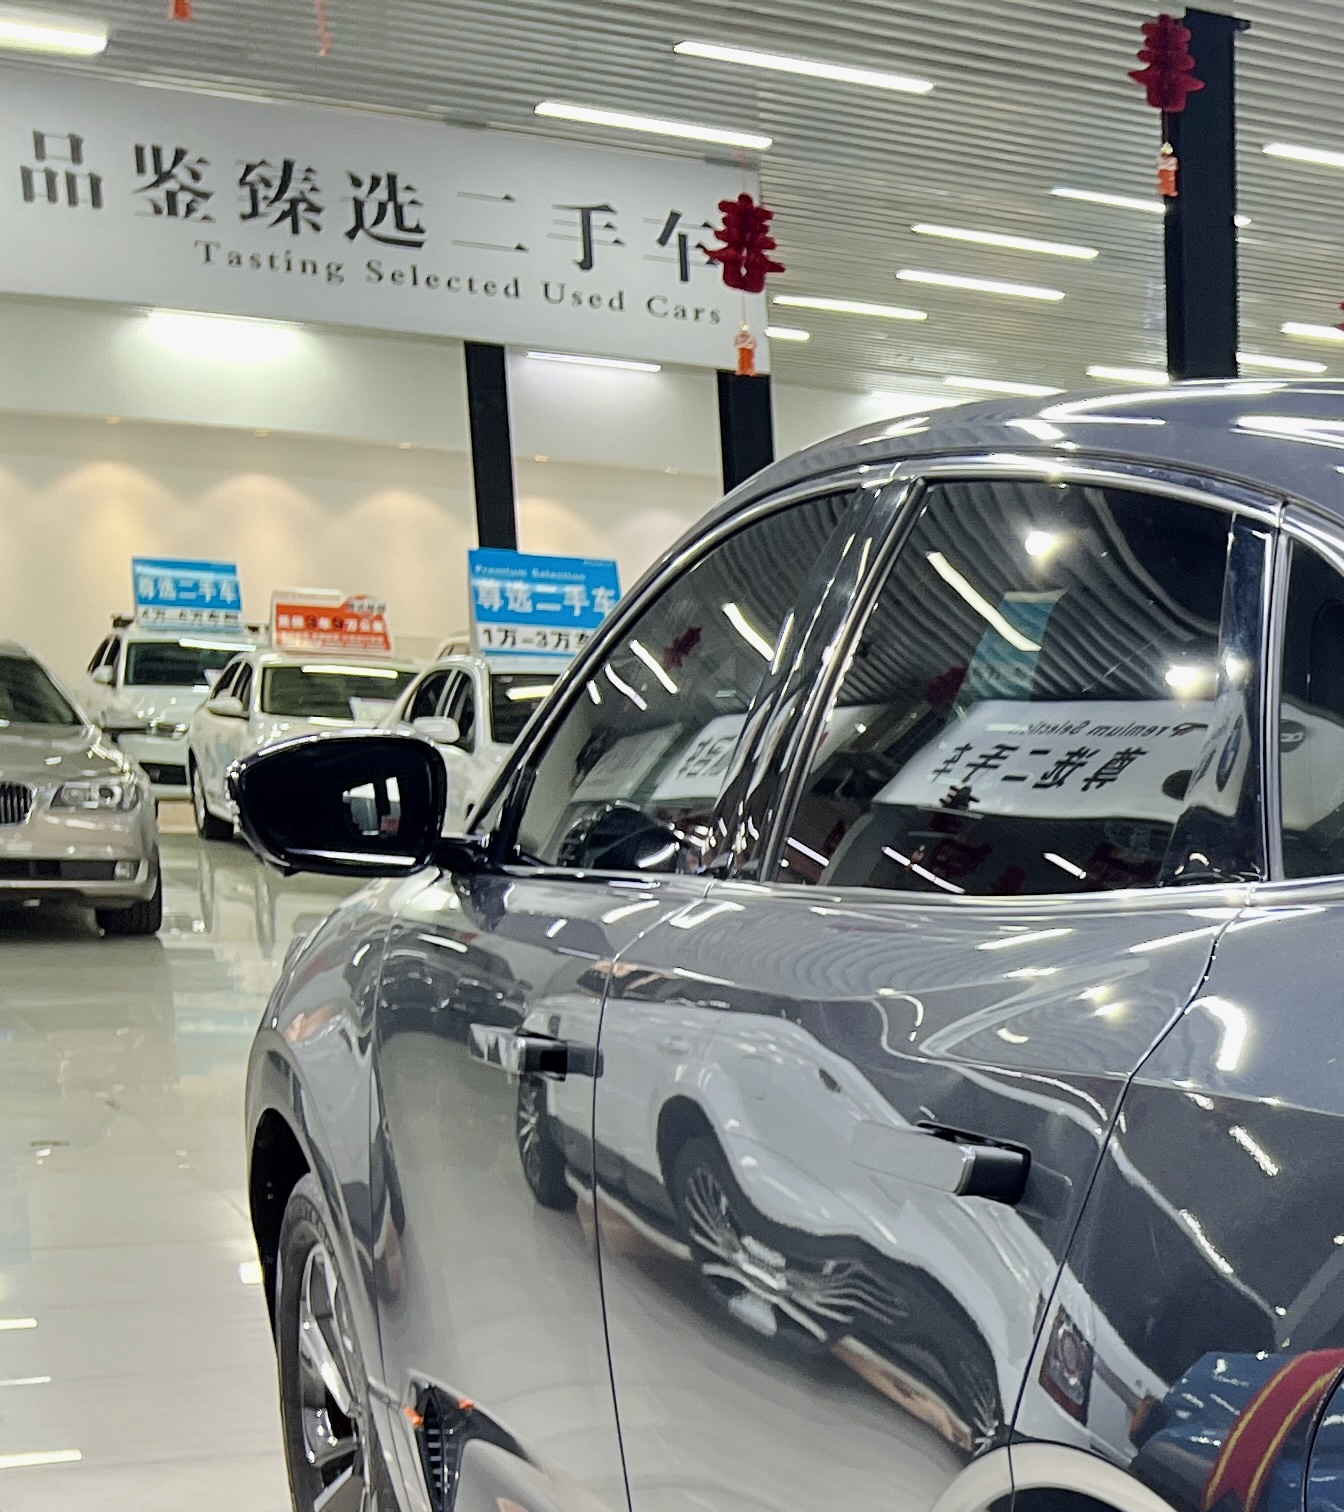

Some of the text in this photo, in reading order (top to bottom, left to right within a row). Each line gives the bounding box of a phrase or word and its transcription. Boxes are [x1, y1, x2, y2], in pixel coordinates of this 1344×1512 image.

[195, 239, 723, 326] Tasting Selected Used Cars
